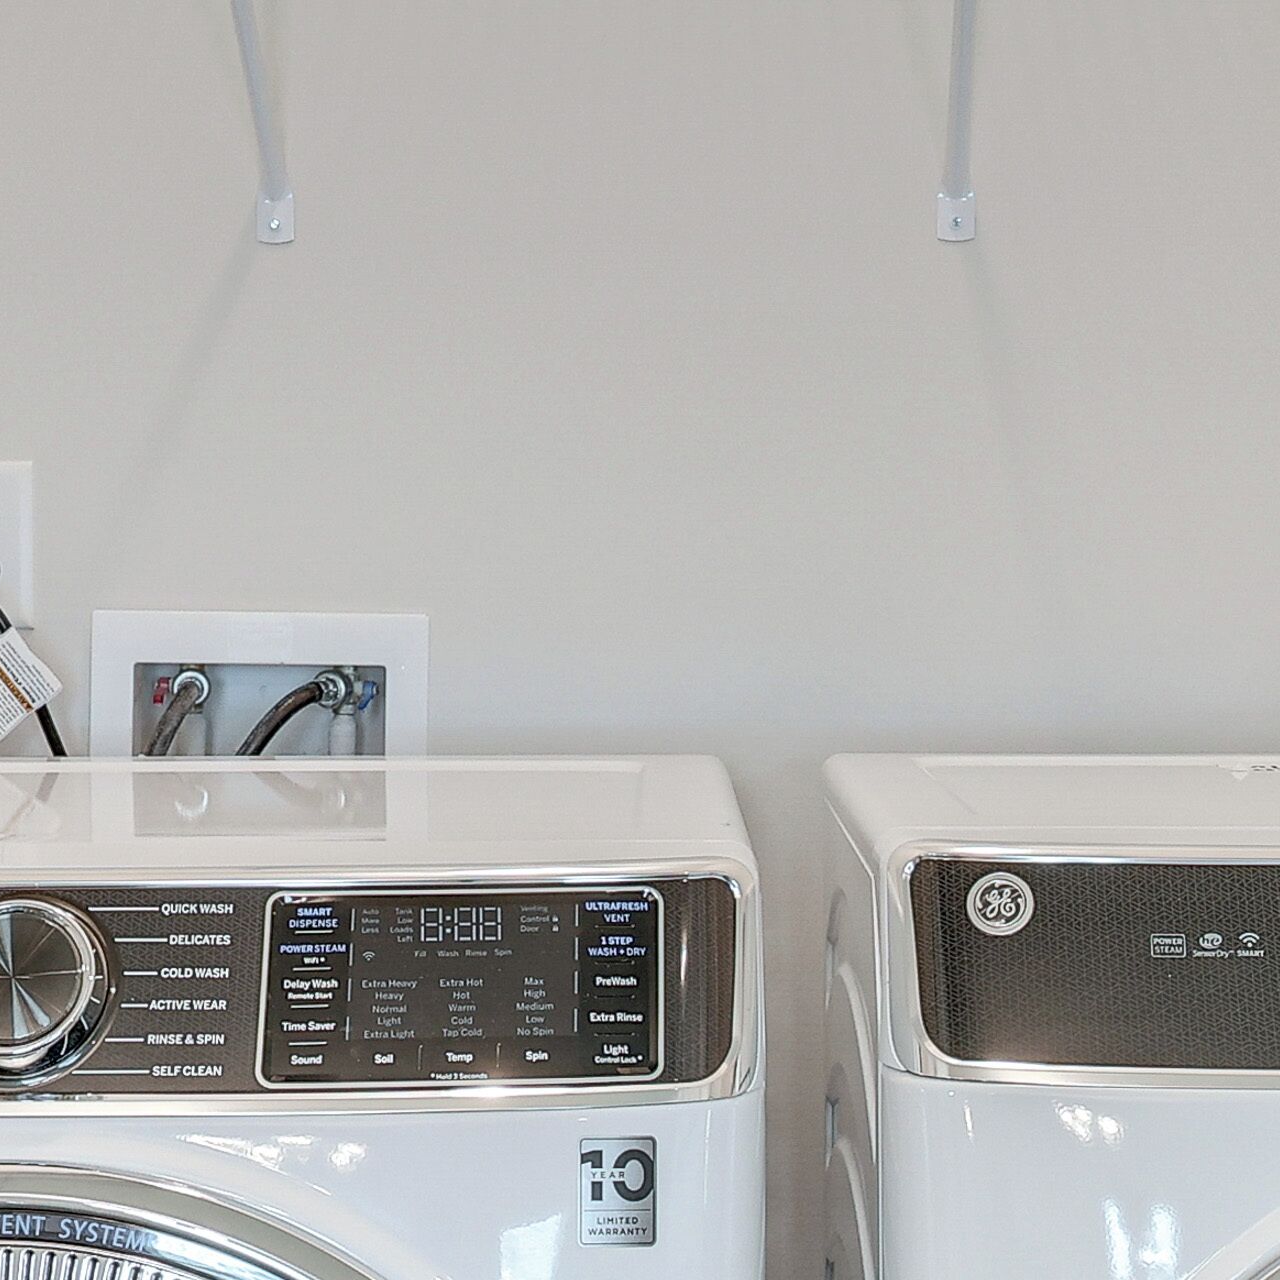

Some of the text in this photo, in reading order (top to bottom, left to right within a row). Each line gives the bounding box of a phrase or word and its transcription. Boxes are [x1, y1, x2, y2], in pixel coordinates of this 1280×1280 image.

[161, 903, 233, 915] QUICK WASH
[585, 901, 649, 912] ULTRAFRESH
[297, 907, 332, 917] SMART
[520, 915, 550, 923] Control
[604, 913, 631, 923] VENT
[289, 919, 338, 928] DISPENSE
[169, 935, 231, 946] DELICATES
[601, 936, 633, 945] 1 STEP
[1153, 937, 1183, 945] POWER
[587, 947, 647, 956] WASH DRY
[1154, 945, 1183, 954] STEAM
[160, 968, 229, 978] COLD WASH
[283, 978, 339, 990] Delay Wash
[361, 979, 418, 989] Extra Heavy
[439, 978, 484, 987] Extra Hot
[524, 977, 544, 986] Max
[595, 976, 637, 987] PreWash
[374, 992, 405, 1001] Heavy
[453, 991, 471, 1000] Hot
[523, 989, 546, 998] High
[149, 1000, 227, 1011] ACTIVE WEAR
[372, 1004, 408, 1013] Normal
[447, 1003, 476, 1012] Warm
[516, 1002, 554, 1011] Medium
[377, 1016, 402, 1027] Light
[450, 1016, 473, 1025] Cold
[525, 1015, 545, 1024] Low
[589, 1013, 643, 1023] Extra Rinse
[281, 1021, 337, 1032] Time Saver
[363, 1029, 415, 1040] Extra Light
[442, 1028, 483, 1038] Tap Cold
[517, 1027, 554, 1037] No Spin
[147, 1034, 225, 1045] RINSE & SPIN
[603, 1044, 629, 1056] Light
[291, 1055, 323, 1065] Sound
[374, 1054, 394, 1064] Soil
[445, 1052, 474, 1063] Temp
[525, 1050, 549, 1062] Spin
[151, 1066, 223, 1077] SELF CLEAN
[581, 1149, 654, 1202] 10
[590, 1171, 625, 1179] YEAR
[597, 1216, 639, 1225] LIMITED
[58, 1218, 145, 1252] SYSTEM
[587, 1227, 648, 1236] WARRANTY
